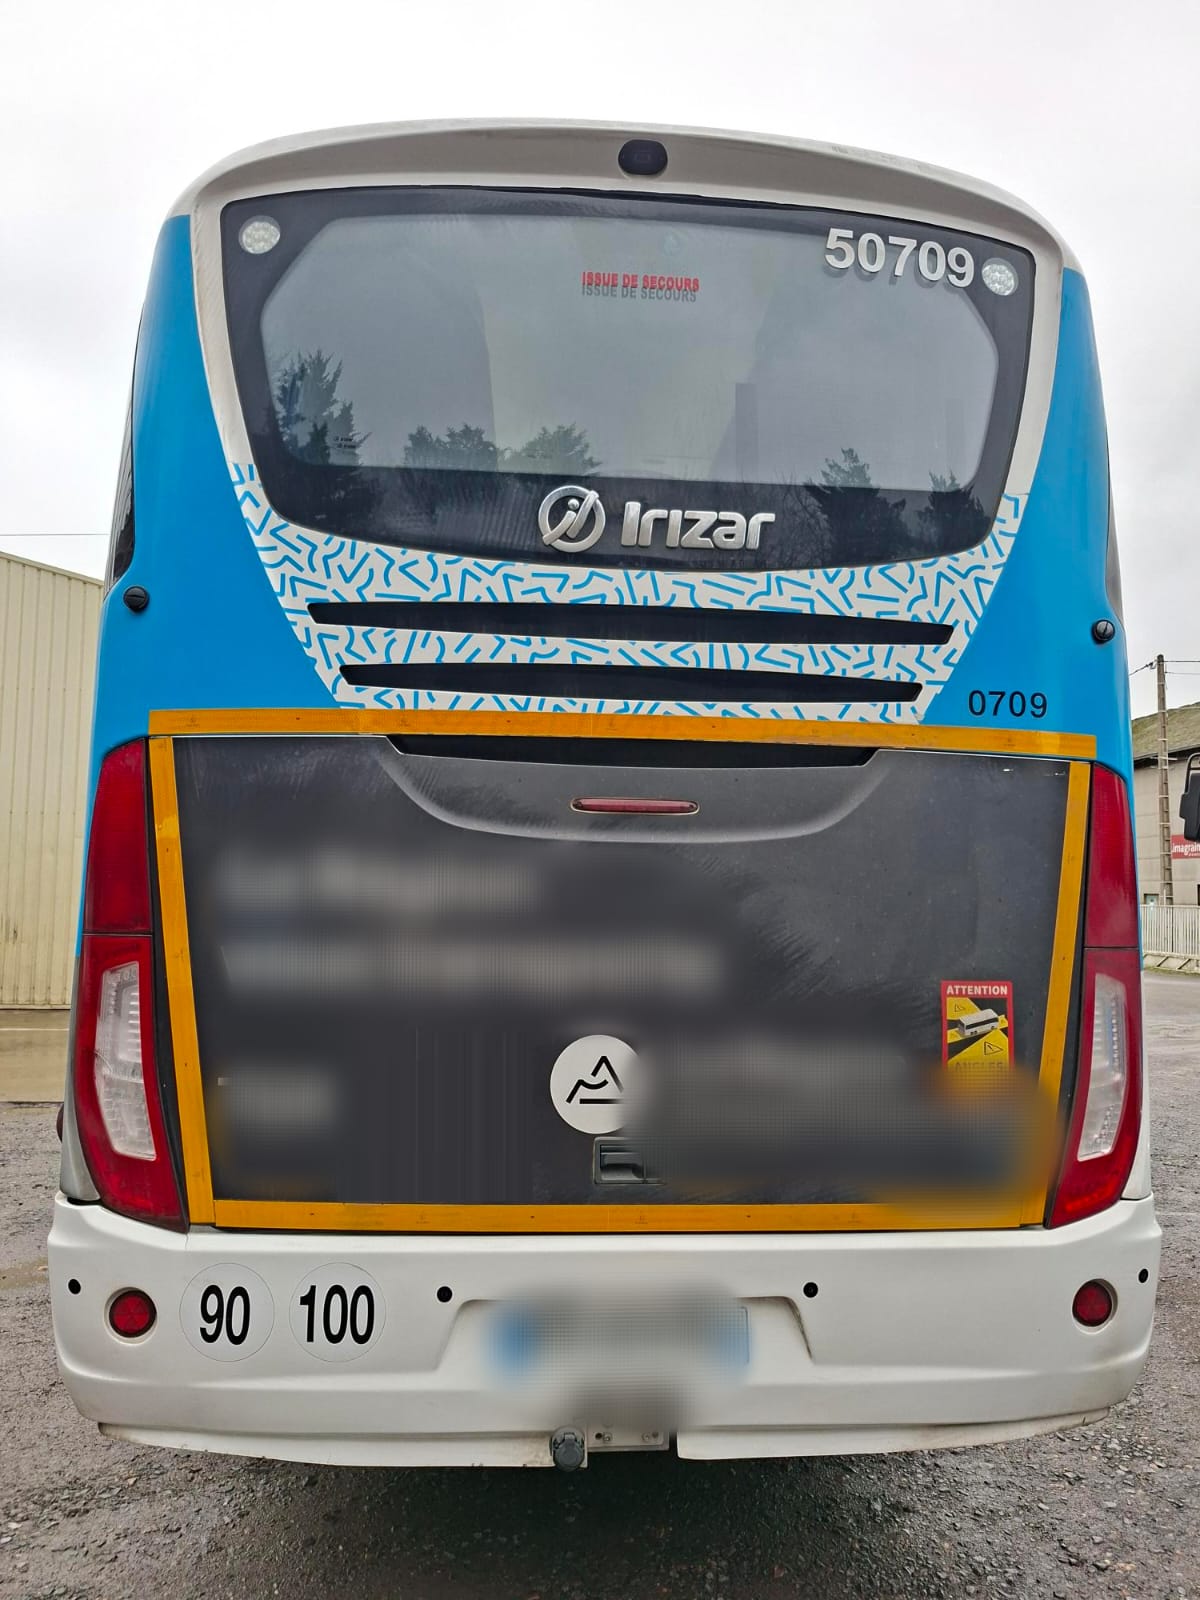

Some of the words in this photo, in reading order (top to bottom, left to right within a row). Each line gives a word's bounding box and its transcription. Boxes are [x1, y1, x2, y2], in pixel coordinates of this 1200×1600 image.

[582, 271, 619, 287] ISSUE
[622, 273, 639, 288] DE
[642, 275, 700, 292] SECOURS
[825, 227, 975, 288] 50709
[620, 501, 776, 550] Irizar
[968, 689, 1048, 719] 0709
[946, 985, 1008, 996] ATTENTION
[200, 1284, 250, 1346] 90
[300, 1284, 375, 1345] 100
